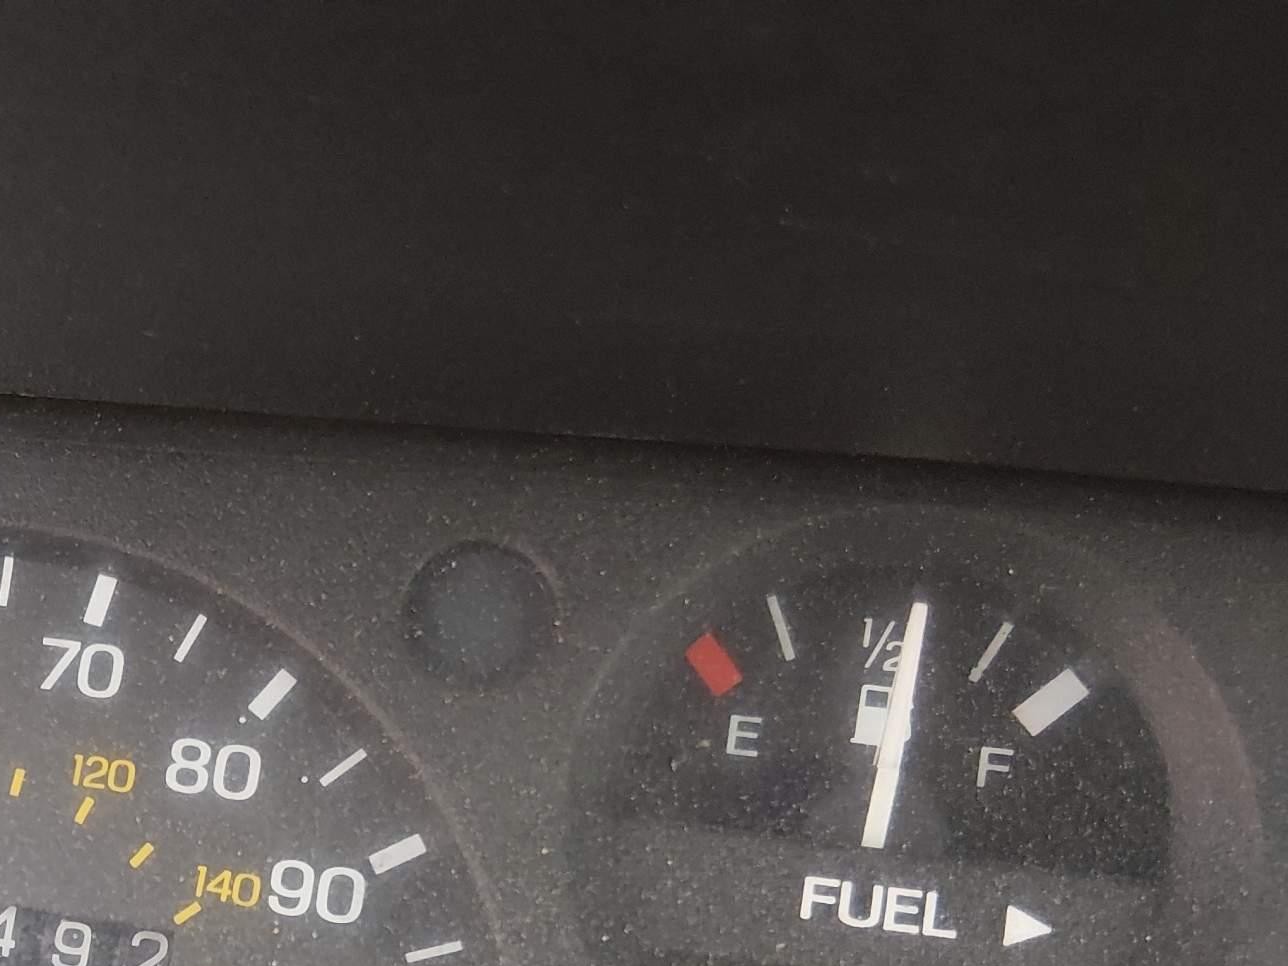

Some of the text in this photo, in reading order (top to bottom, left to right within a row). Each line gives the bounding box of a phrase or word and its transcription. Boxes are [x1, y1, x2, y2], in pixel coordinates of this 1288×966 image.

[40, 637, 125, 698] 70
[726, 715, 762, 757] E
[73, 754, 136, 794] 120
[165, 738, 262, 801] 80
[976, 746, 1015, 788] F
[195, 866, 262, 908] 140
[268, 859, 366, 924] 90
[799, 876, 958, 940] FUEL
